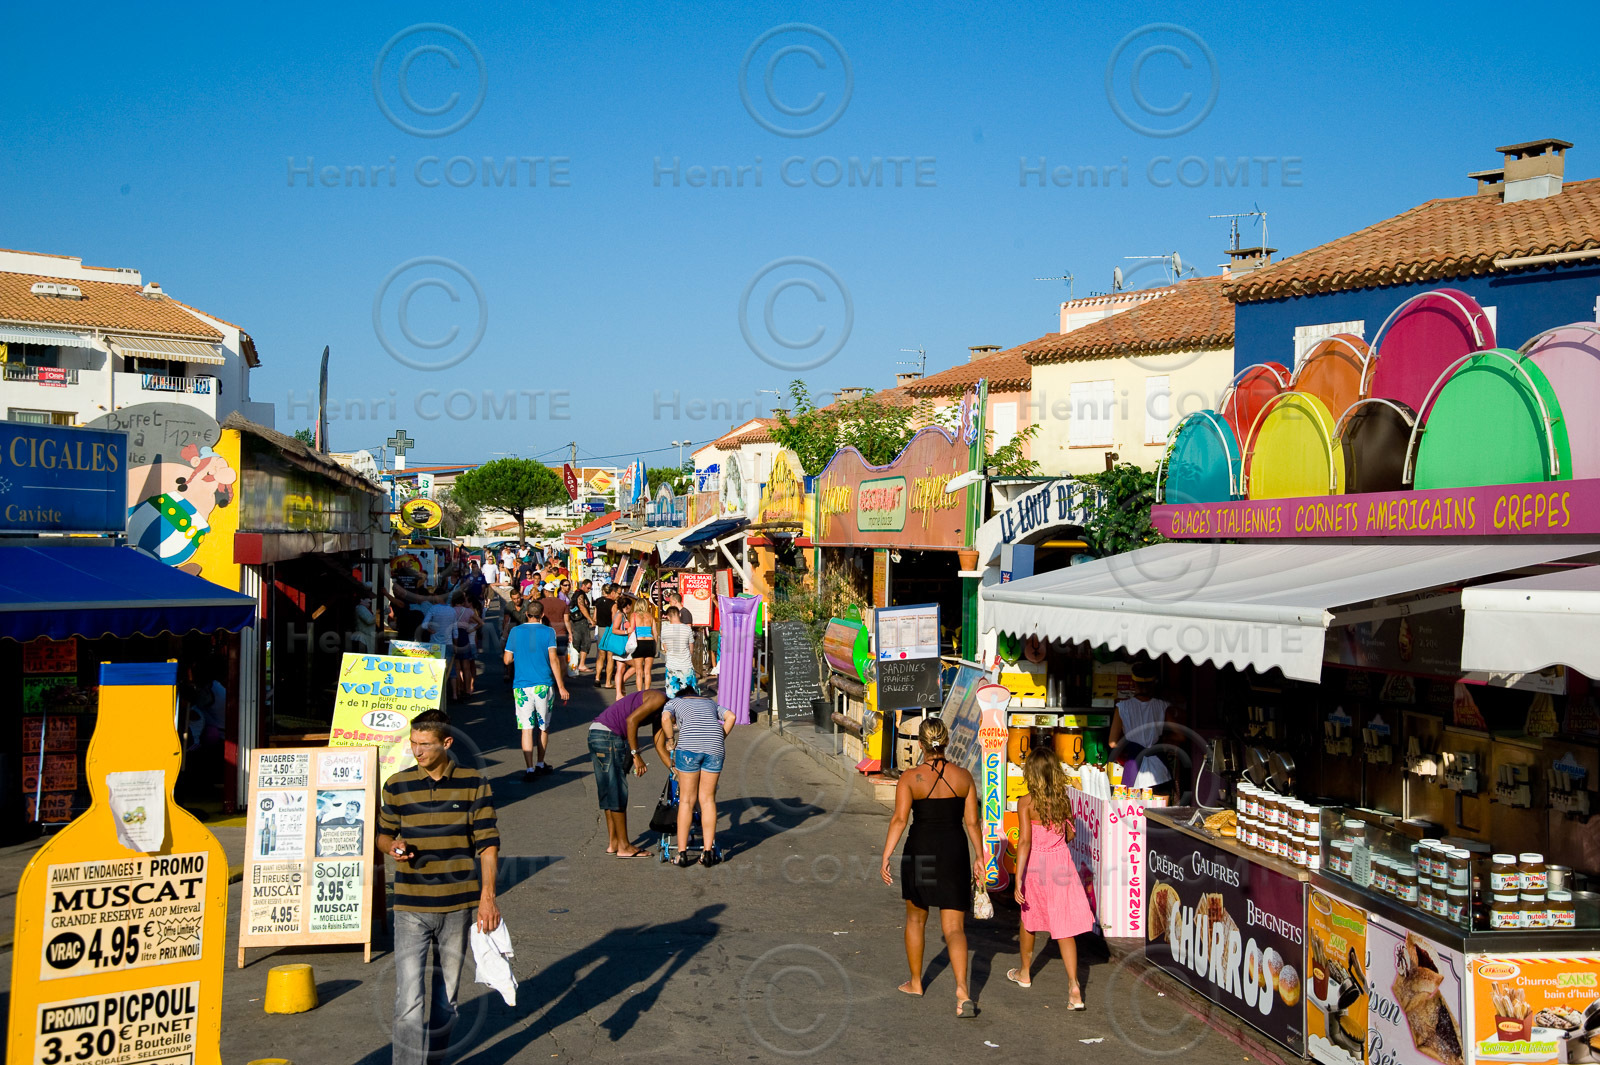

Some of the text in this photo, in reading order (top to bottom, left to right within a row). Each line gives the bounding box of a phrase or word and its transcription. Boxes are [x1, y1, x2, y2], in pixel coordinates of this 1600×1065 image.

[9, 436, 119, 473] CIGALES
[566, 472, 575, 492] TABAC
[591, 479, 603, 492] PRESSE
[5, 504, 62, 523] Caviste
[1000, 508, 1016, 544] LE
[1018, 489, 1051, 533] LOUP
[1057, 485, 1076, 521] DE
[1171, 491, 1571, 534] GLACES ITALIENNES CORNETS AMERICAINS CREPES
[362, 656, 424, 674] Tout
[384, 673, 395, 684] à
[340, 681, 439, 700] volonté
[347, 699, 359, 707] de
[371, 701, 393, 710] plats
[333, 728, 402, 743] Poissons
[978, 727, 1009, 738] TROPICAL
[984, 738, 1005, 749] SNOW
[260, 754, 295, 763] FAUGERES
[273, 764, 289, 774] 4.50
[333, 767, 350, 778] 4.90
[985, 753, 1001, 887] GRANITAS
[1071, 796, 1100, 839] LACES
[334, 844, 357, 852] JOHNNY
[52, 867, 80, 883] AVANT
[83, 863, 134, 880] VENDANGES
[150, 855, 204, 877] PROMO
[262, 874, 289, 883] TIREUSE
[315, 862, 360, 879] Soleil
[1128, 820, 1141, 931] ITALIENNES
[1149, 850, 1240, 888] CRÊPES GAUFRES
[52, 877, 203, 913] MUSCAT
[253, 885, 302, 897] MUSCAT
[316, 881, 344, 902] 3.95
[51, 902, 201, 928] GRANDE RESERVE AOP Mireval
[271, 906, 292, 923] 4.95
[314, 903, 360, 913] MUSCAT
[320, 914, 352, 922] MOELLEUX
[1246, 898, 1303, 945] BEIGNETS
[50, 941, 81, 962] VRAC
[88, 925, 140, 968] 4.95
[144, 941, 152, 950] le
[1330, 934, 1347, 953] SANS
[141, 951, 157, 961] litre
[1168, 900, 1274, 1016] CHURROS
[1516, 974, 1595, 986] Churros SANS
[1544, 989, 1600, 999] bain d'huile
[45, 987, 195, 1030] PROMO PICPOUL
[42, 1028, 116, 1065] 3.30
[138, 1017, 193, 1038] PINET
[119, 1033, 192, 1054] la Bouteille
[95, 1044, 192, 1065] CIGALES SELECTION JP
